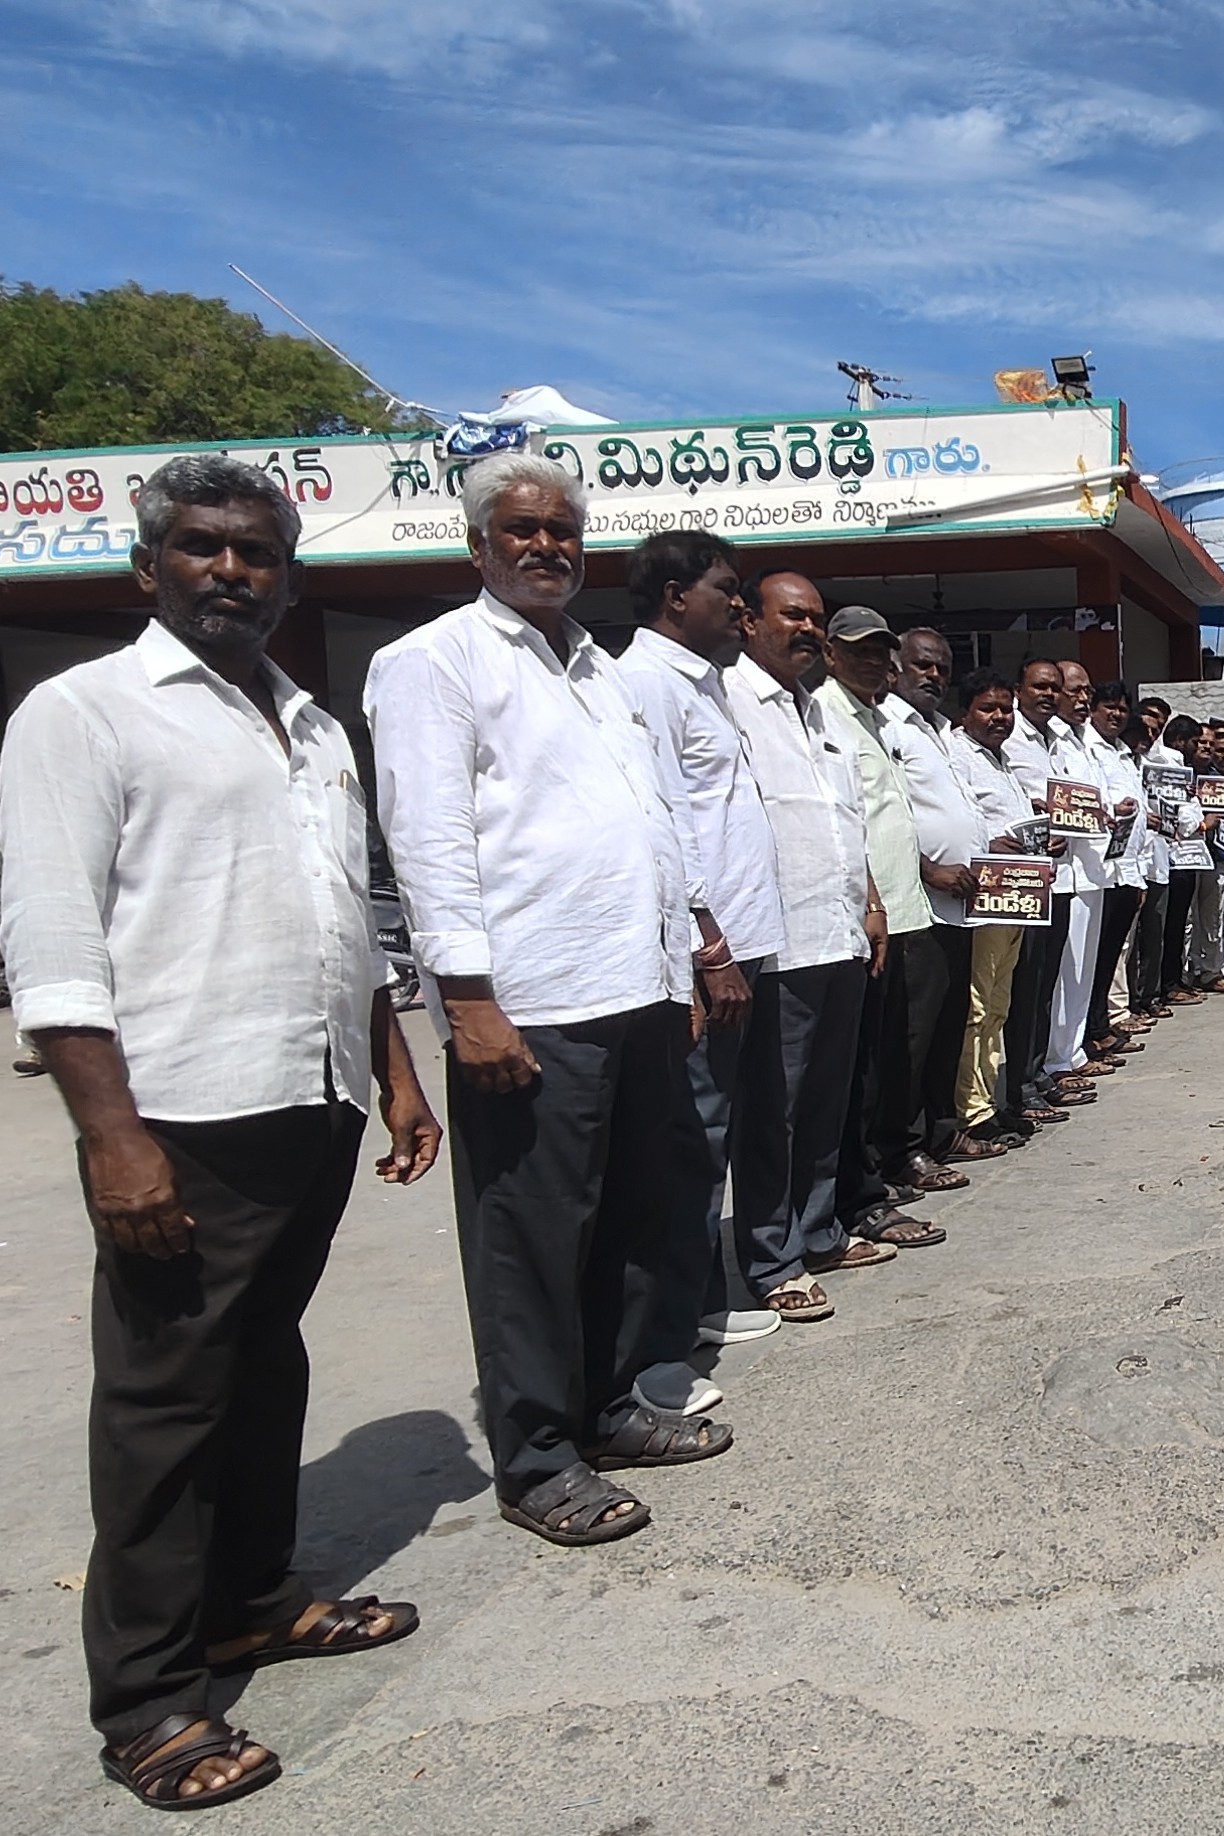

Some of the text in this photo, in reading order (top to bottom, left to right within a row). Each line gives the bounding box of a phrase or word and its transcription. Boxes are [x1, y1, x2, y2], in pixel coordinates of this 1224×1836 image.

[0, 467, 104, 516] యతి
[0, 516, 136, 561] సదు
[392, 513, 467, 542] రాజంపే
[679, 506, 719, 532] గారి
[724, 500, 822, 530] నిధులతో
[1051, 808, 1102, 833] రెండేళ్లు
[974, 889, 1042, 919] రెండేళ్లు
